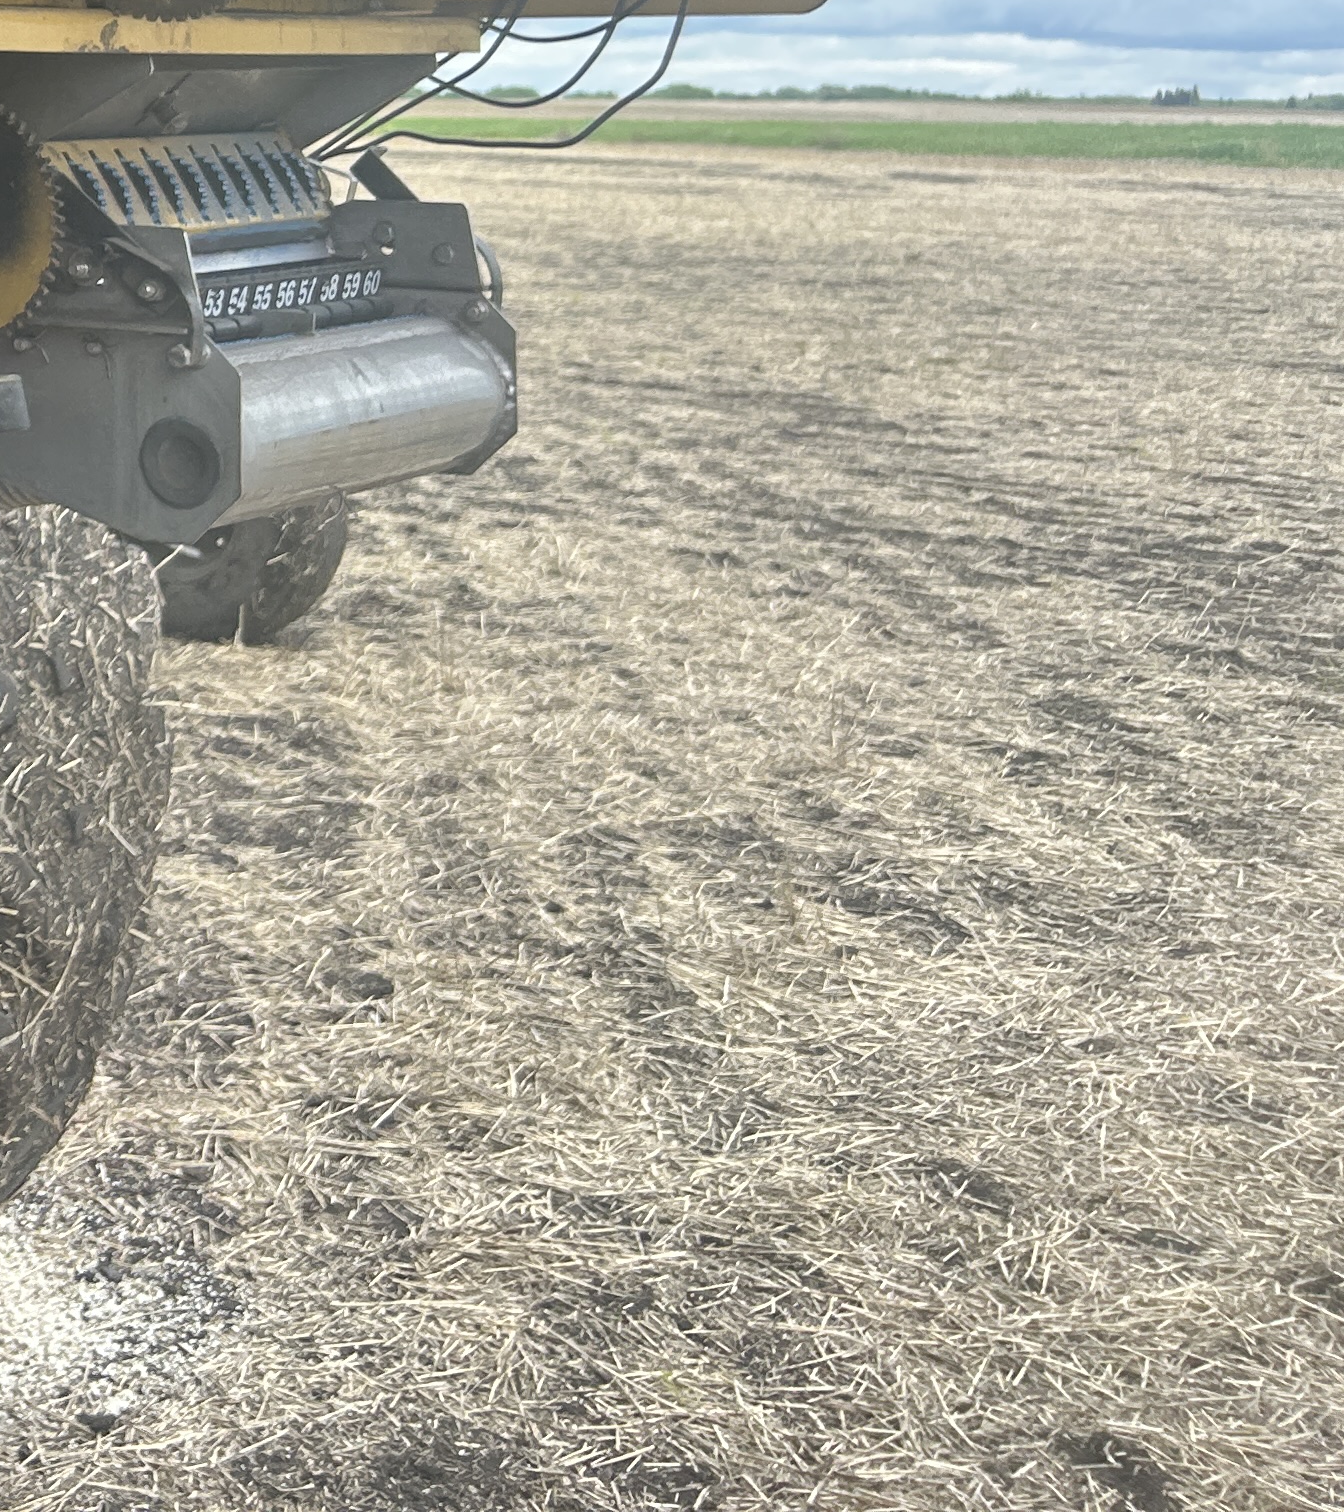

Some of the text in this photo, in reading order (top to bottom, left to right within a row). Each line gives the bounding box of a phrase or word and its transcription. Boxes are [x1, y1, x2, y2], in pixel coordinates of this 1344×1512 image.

[203, 269, 382, 317] 53 54 55 56 57 58 59 60
